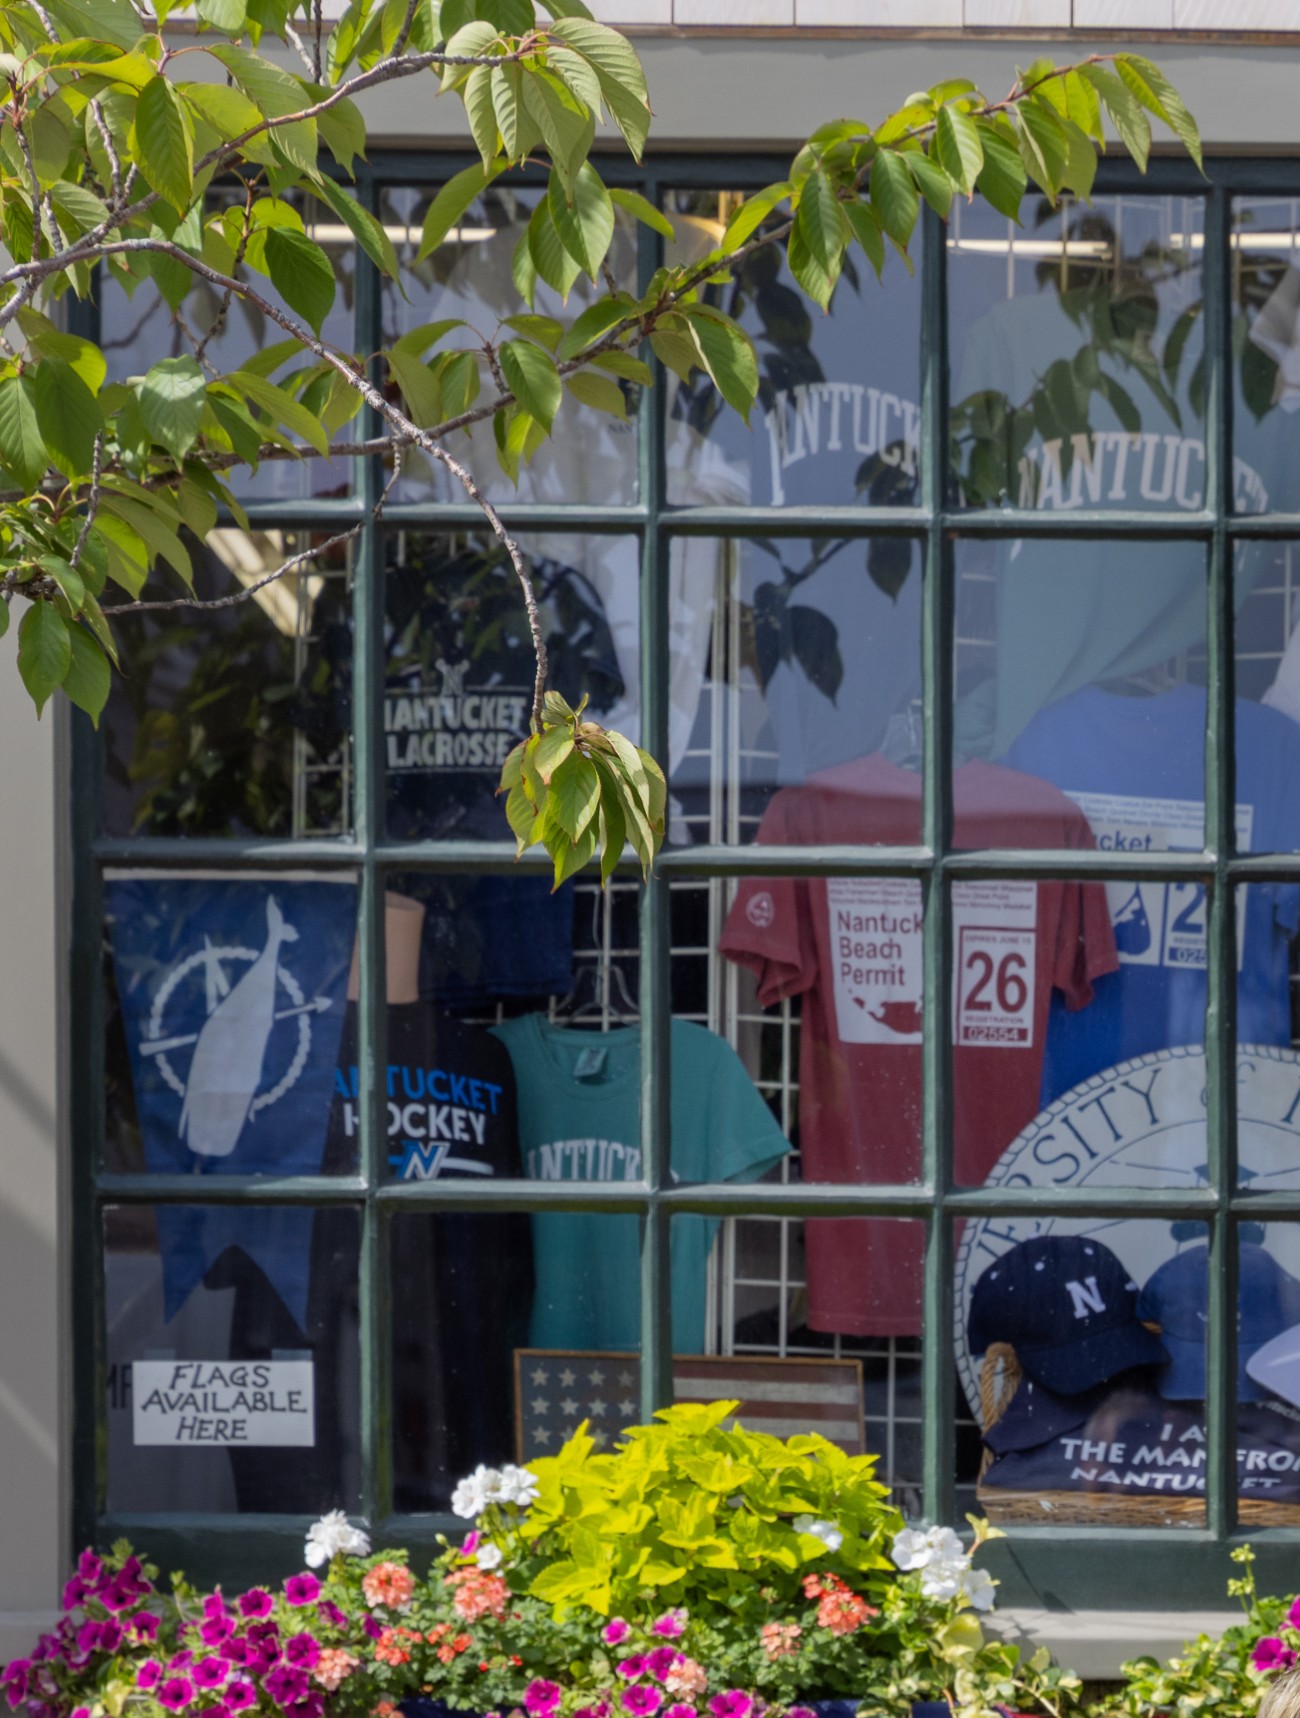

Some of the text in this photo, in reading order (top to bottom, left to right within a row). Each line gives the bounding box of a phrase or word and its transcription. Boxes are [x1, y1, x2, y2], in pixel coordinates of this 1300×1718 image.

[839, 936, 902, 959] Beach
[841, 962, 905, 986] Permit
[964, 951, 1028, 1014] 26
[968, 1027, 1019, 1041] 02554
[1065, 1276, 1106, 1319] N
[169, 1363, 271, 1390] FLAGS
[140, 1388, 308, 1415] AVAILABLE
[175, 1415, 248, 1441] HERE
[1060, 1438, 1126, 1464] THE
